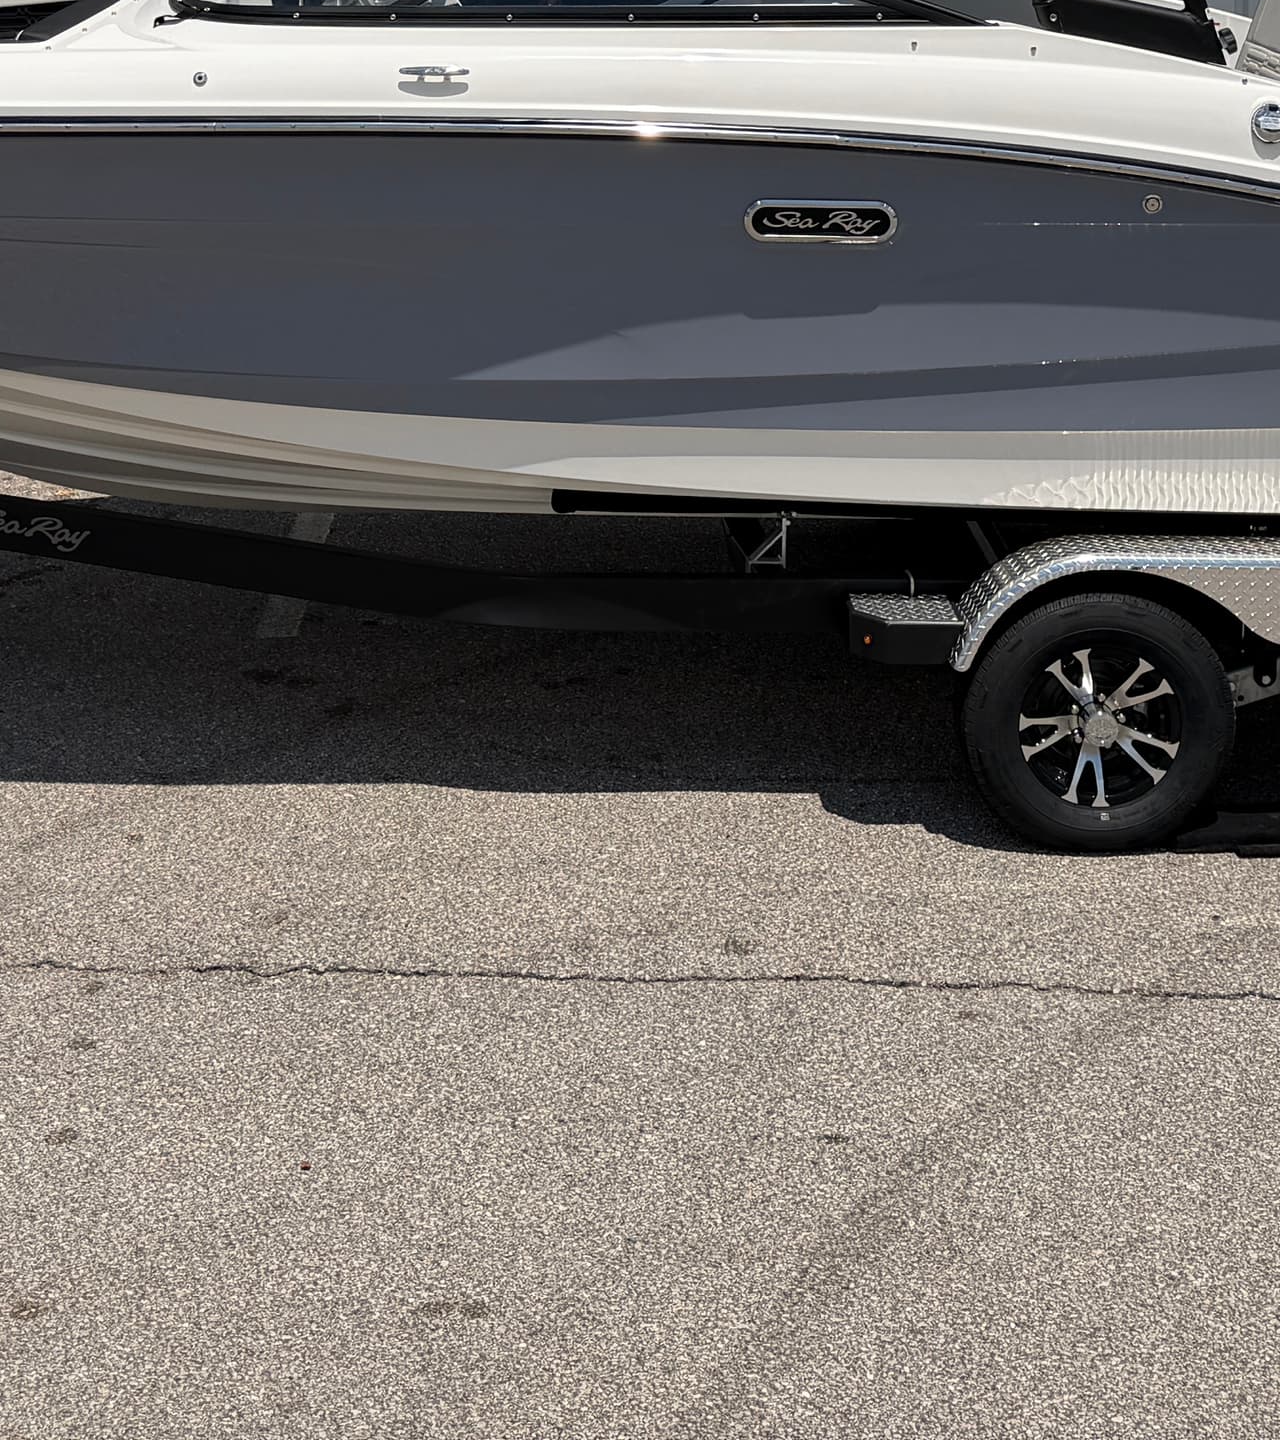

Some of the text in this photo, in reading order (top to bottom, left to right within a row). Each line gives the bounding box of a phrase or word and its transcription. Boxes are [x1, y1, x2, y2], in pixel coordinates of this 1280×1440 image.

[762, 211, 880, 234] Sea Ray
[24, 517, 91, 552] Ray
